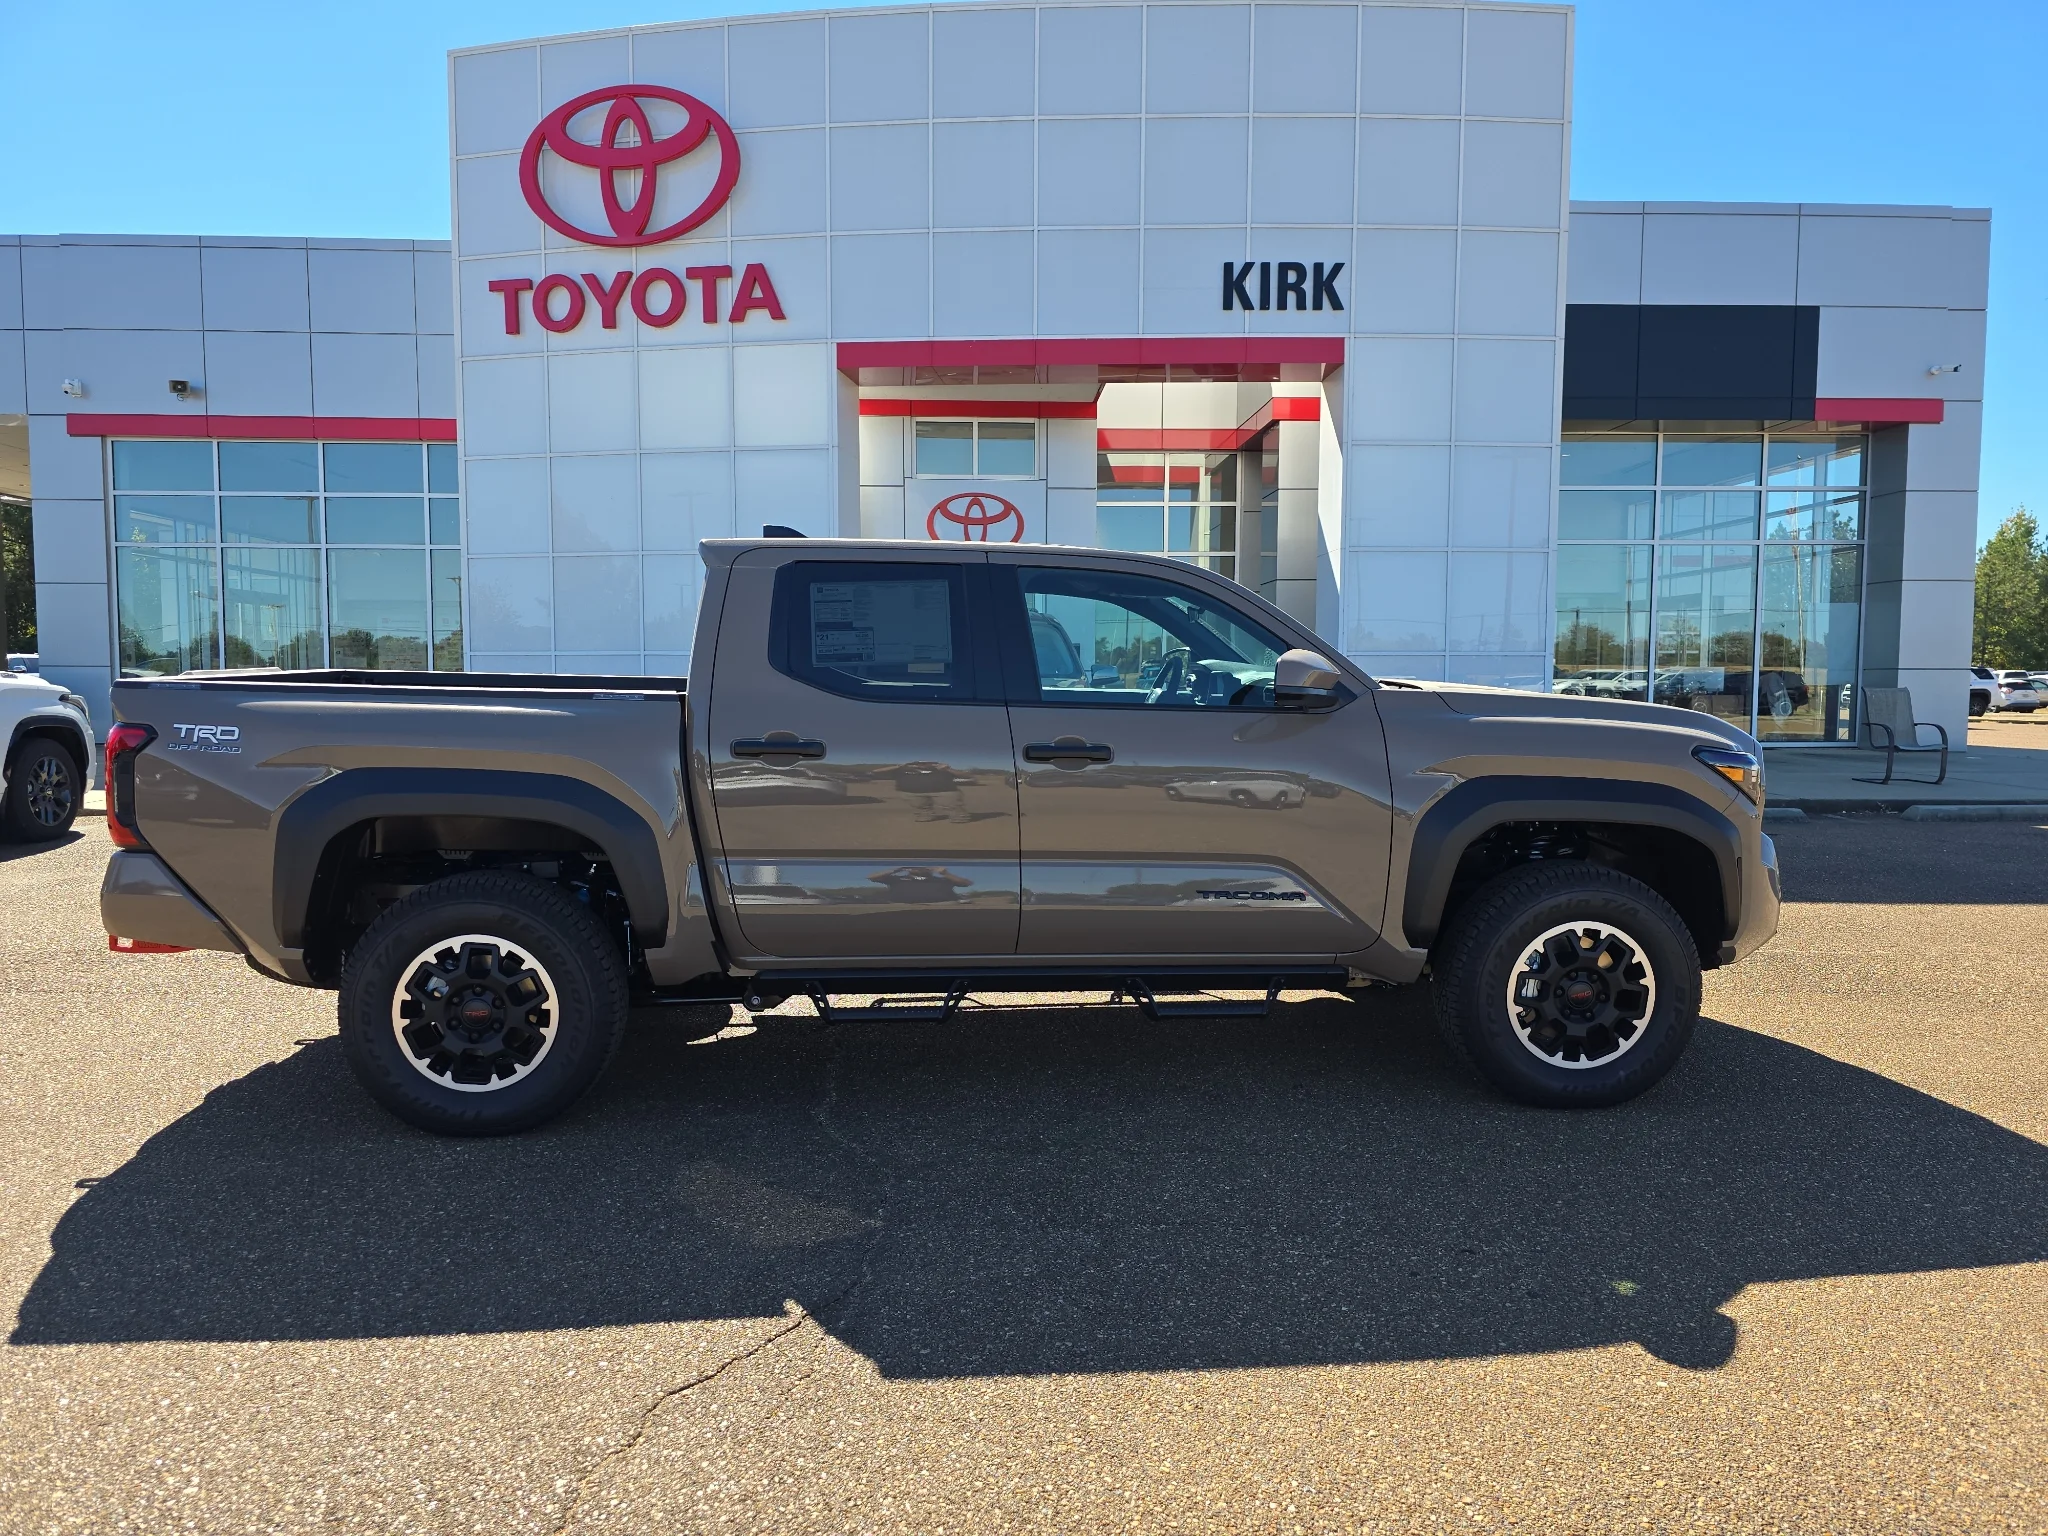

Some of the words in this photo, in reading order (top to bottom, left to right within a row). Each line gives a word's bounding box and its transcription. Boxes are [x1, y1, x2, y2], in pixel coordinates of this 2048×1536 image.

[1222, 262, 1346, 310] KIRK
[488, 263, 787, 336] TOYOTA
[173, 723, 240, 744] TRD
[167, 743, 199, 751] OFF
[1196, 890, 1307, 901] TACOMA
